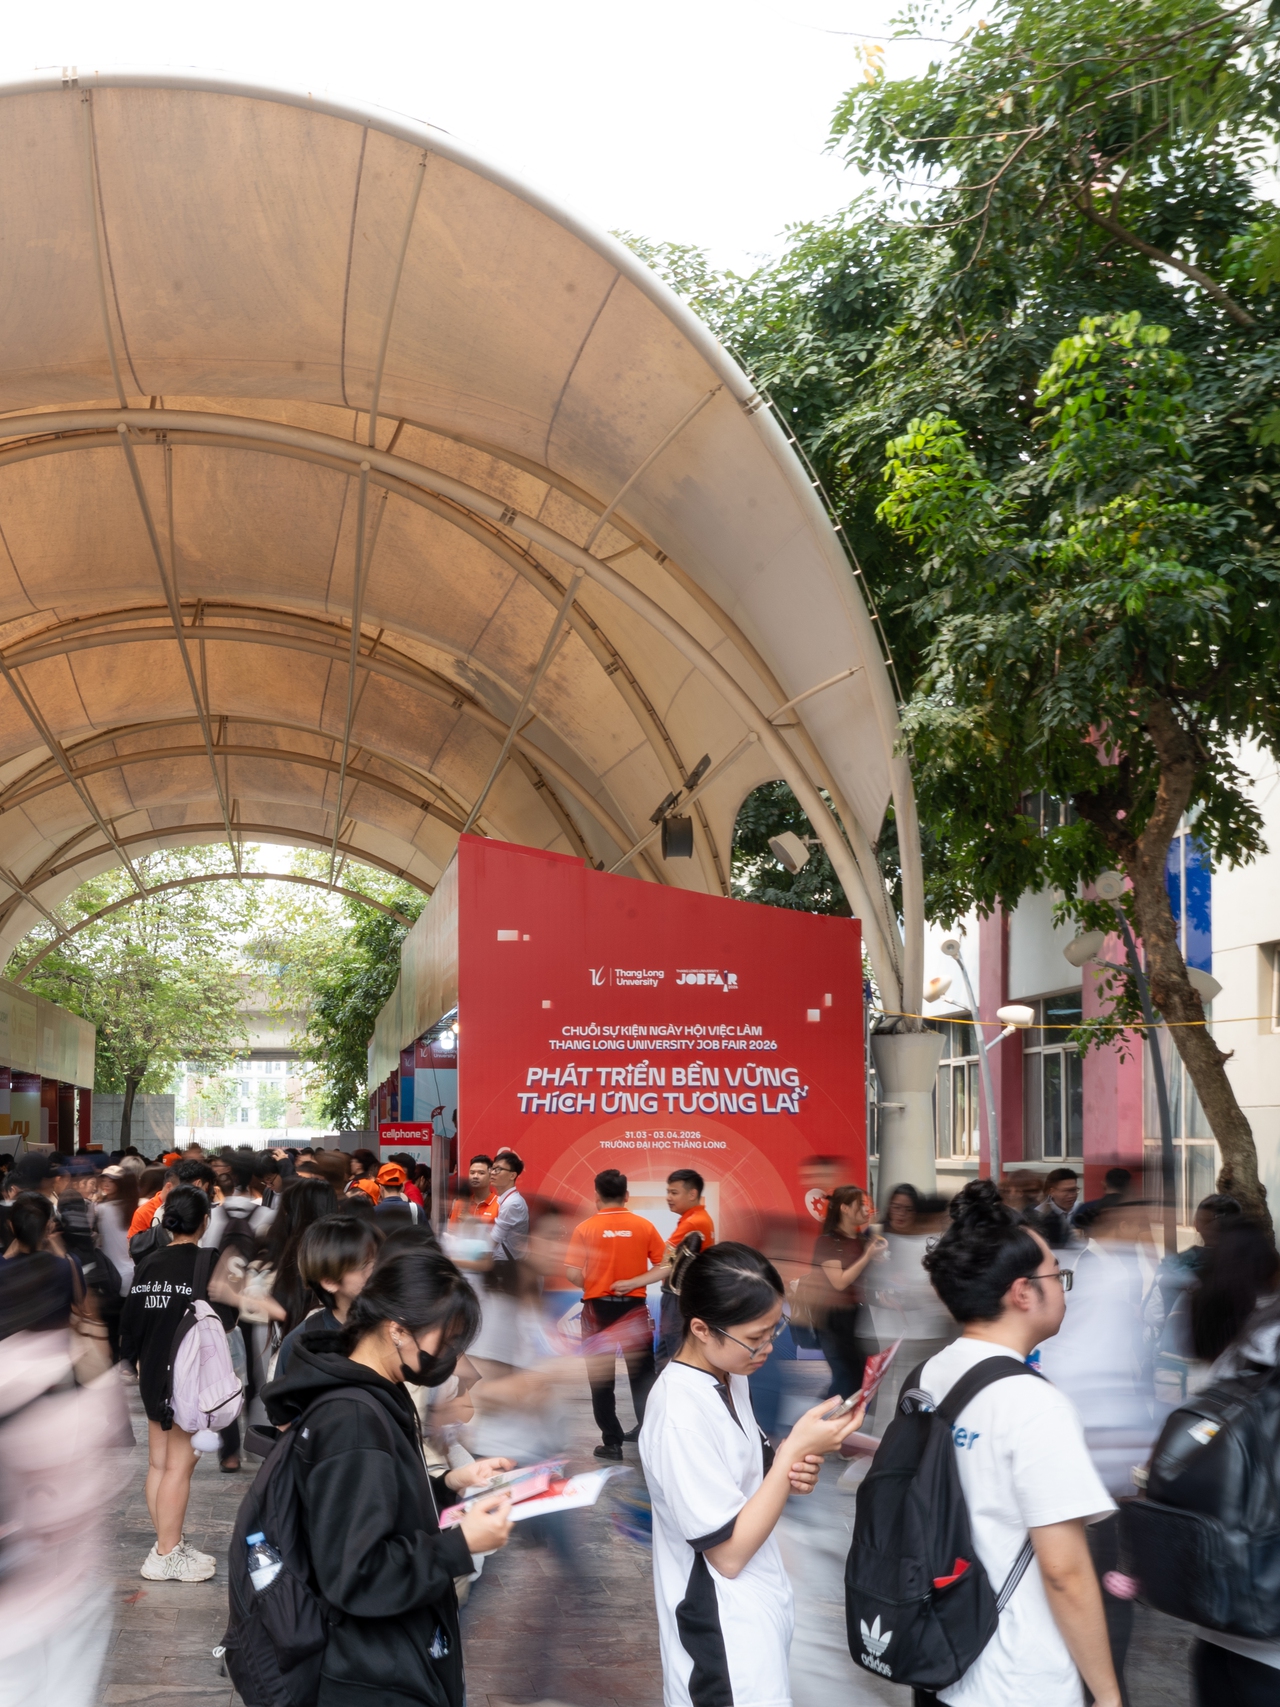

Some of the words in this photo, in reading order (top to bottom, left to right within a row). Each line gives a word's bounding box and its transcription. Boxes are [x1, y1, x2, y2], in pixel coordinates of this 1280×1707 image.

[614, 969, 642, 979] Thang
[643, 969, 664, 979] Long
[676, 974, 706, 985] JOB
[616, 978, 658, 988] University
[562, 1022, 600, 1036] CHUỖI
[602, 1025, 620, 1037] SỰ
[621, 1024, 647, 1038] KIỆN
[649, 1024, 682, 1036] NGÀY
[684, 1024, 706, 1038] HỘI
[708, 1024, 735, 1038] VIỆC
[737, 1024, 762, 1036] LÀM
[549, 1040, 590, 1050] THANG
[593, 1040, 624, 1050] LONG
[627, 1040, 695, 1050] UNIVERSITY
[696, 1040, 720, 1050] JOB
[722, 1040, 747, 1050] FAIR
[749, 1040, 777, 1050] 2026
[526, 1064, 593, 1086] PHÁT
[672, 1060, 719, 1086] BỀN
[724, 1063, 800, 1086] VỮNG
[517, 1090, 596, 1113] THÍCH
[601, 1090, 658, 1113] ỨNG
[663, 1092, 757, 1113] TƯƠNG
[763, 1088, 805, 1113] LAI
[625, 1131, 647, 1139] 31.03
[653, 1131, 701, 1139] 03.04.2026
[600, 1140, 635, 1149] TRƯỜNG
[636, 1140, 650, 1150] ĐẠI
[652, 1140, 670, 1150] HỌC
[672, 1140, 702, 1149] THĂNG
[704, 1141, 726, 1149] LONG
[152, 1281, 161, 1292] de
[163, 1281, 172, 1292] la
[175, 1283, 192, 1295] vie
[144, 1296, 171, 1308] ADLV
[861, 1652, 892, 1677] adidas
